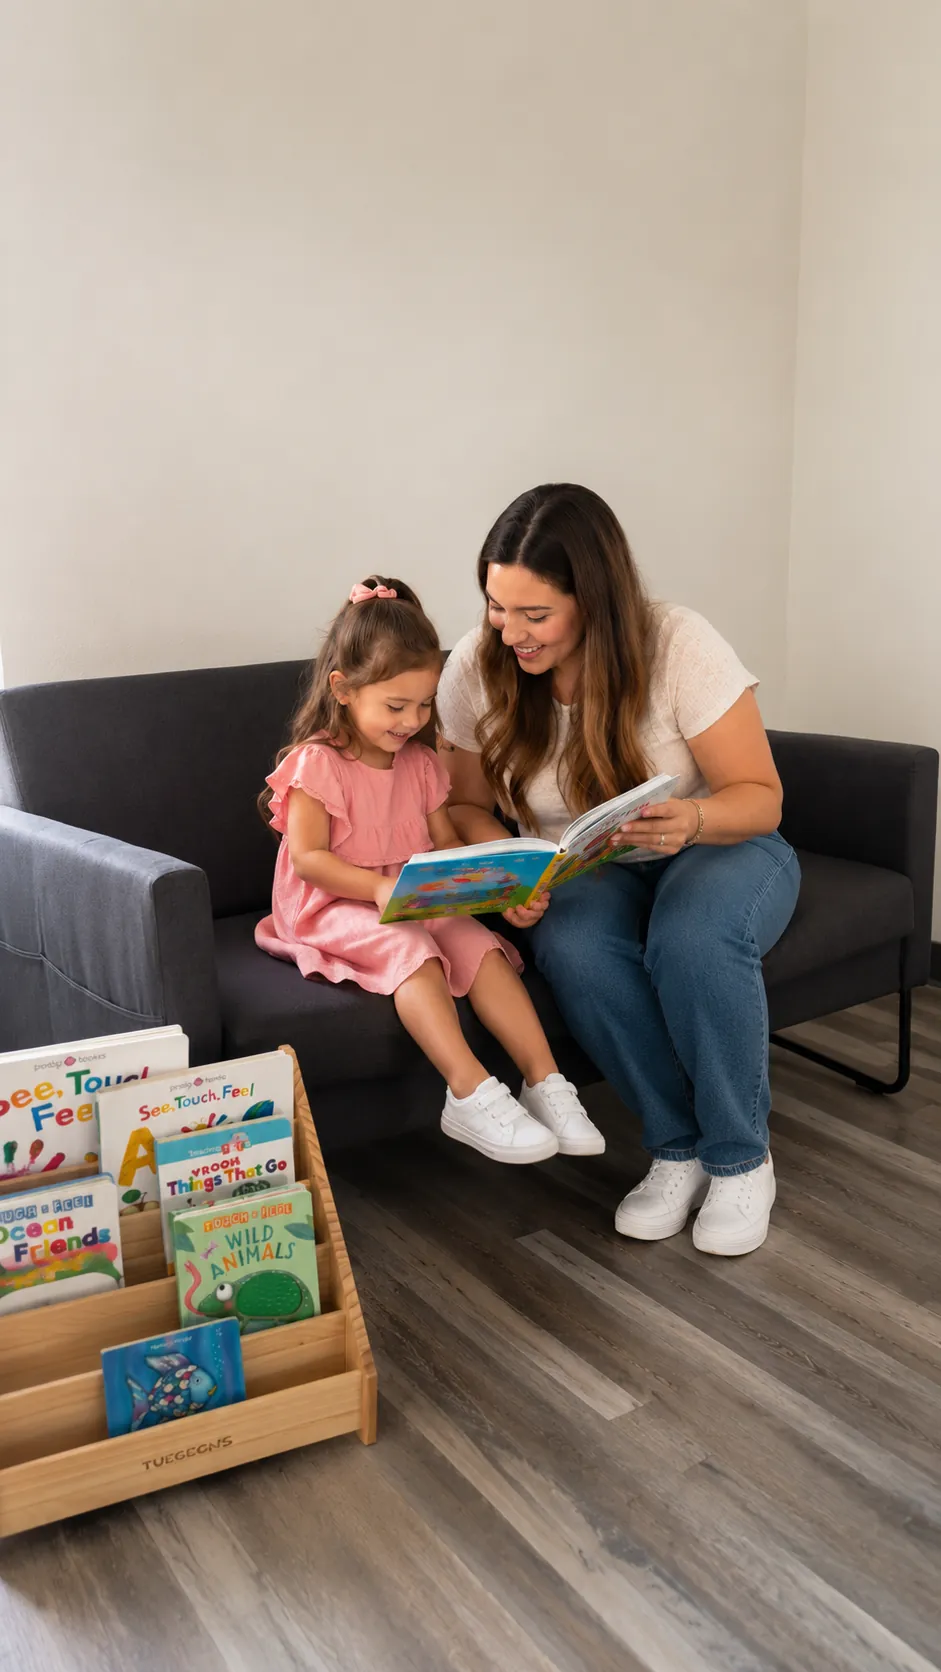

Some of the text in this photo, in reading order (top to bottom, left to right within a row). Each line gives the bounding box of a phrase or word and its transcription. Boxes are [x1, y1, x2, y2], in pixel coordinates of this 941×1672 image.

[222, 1082, 255, 1099] Feel
[31, 1102, 94, 1132] Fee
[166, 1158, 288, 1197] Things That Go
[224, 1224, 274, 1251] WILD
[210, 1241, 296, 1281] ANIMALS
